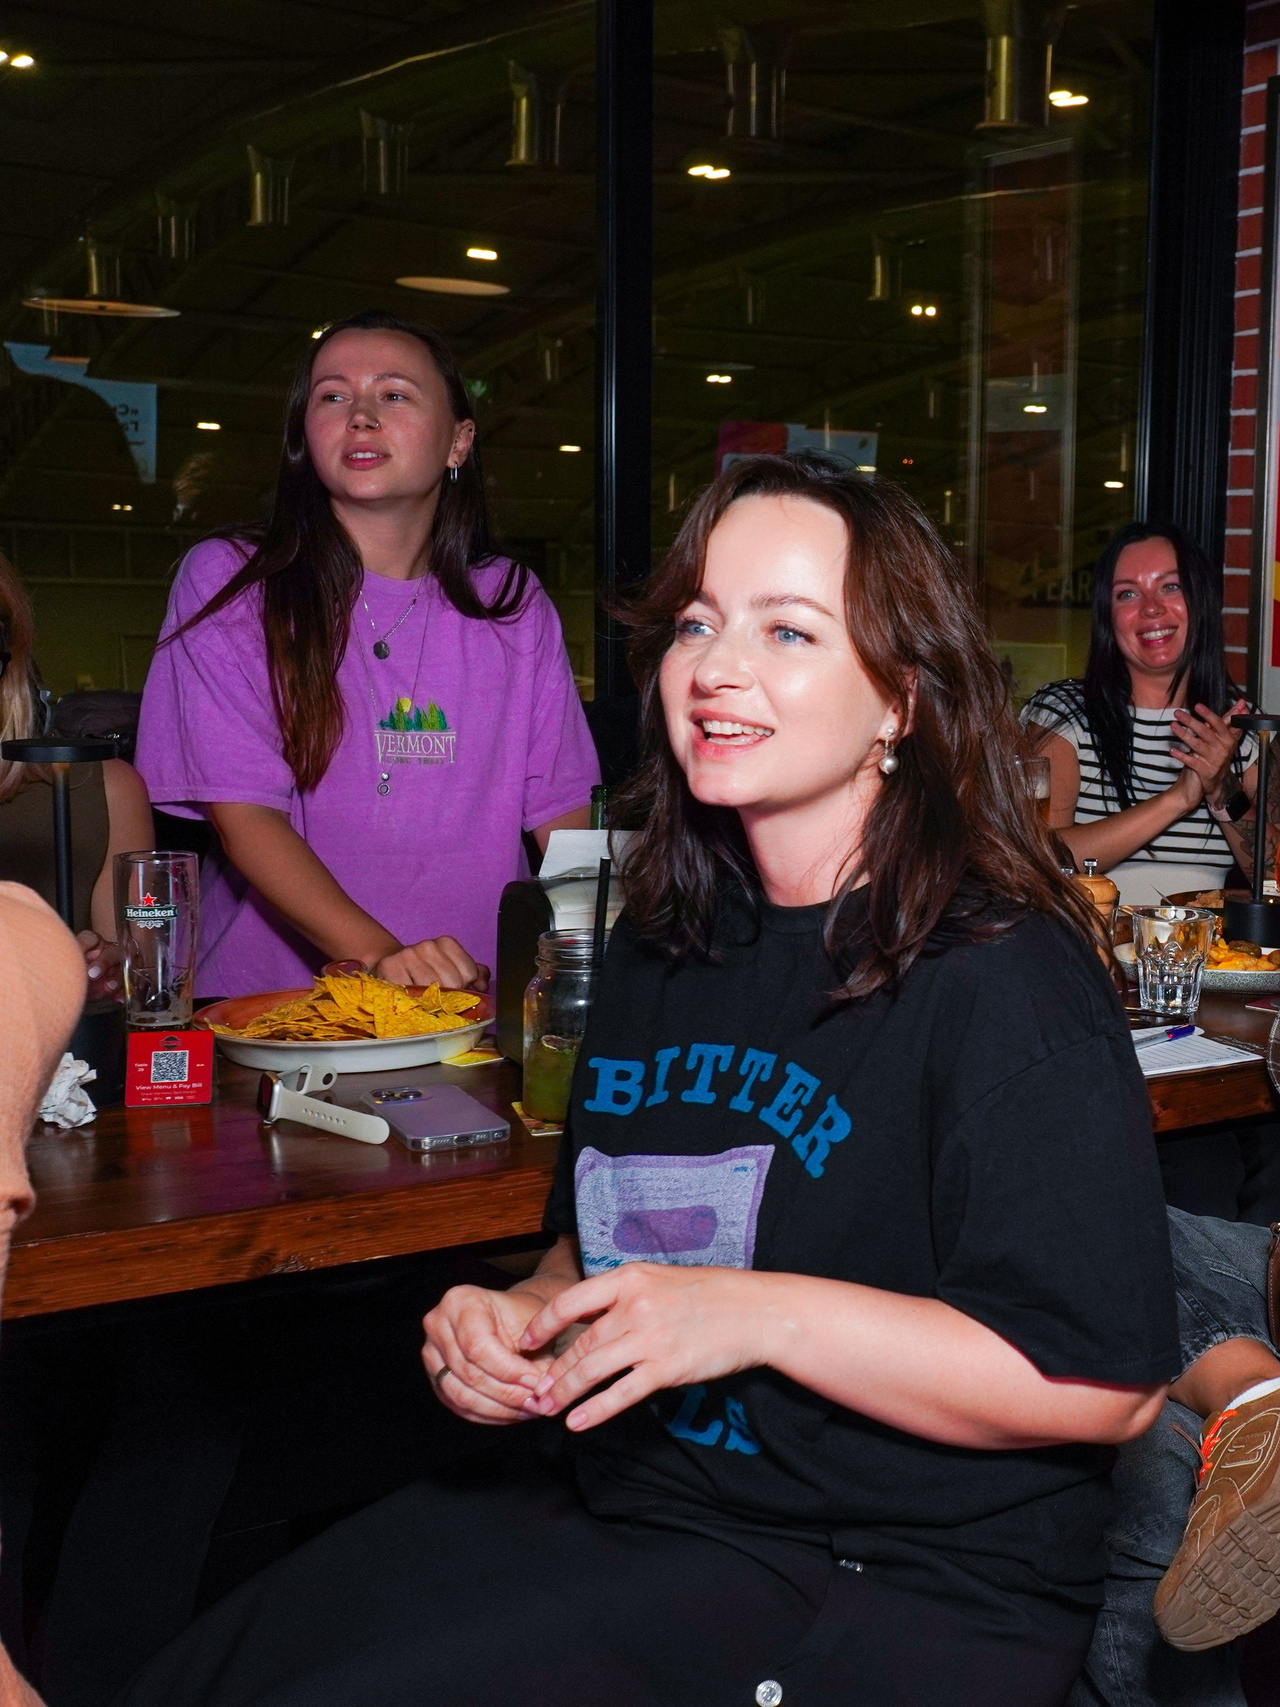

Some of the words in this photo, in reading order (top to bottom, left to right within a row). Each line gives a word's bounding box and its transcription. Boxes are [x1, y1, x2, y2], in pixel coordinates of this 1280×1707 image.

[374, 733, 456, 763] VERMONT
[126, 908, 175, 918] Heineken
[584, 1042, 852, 1179] BITTER
